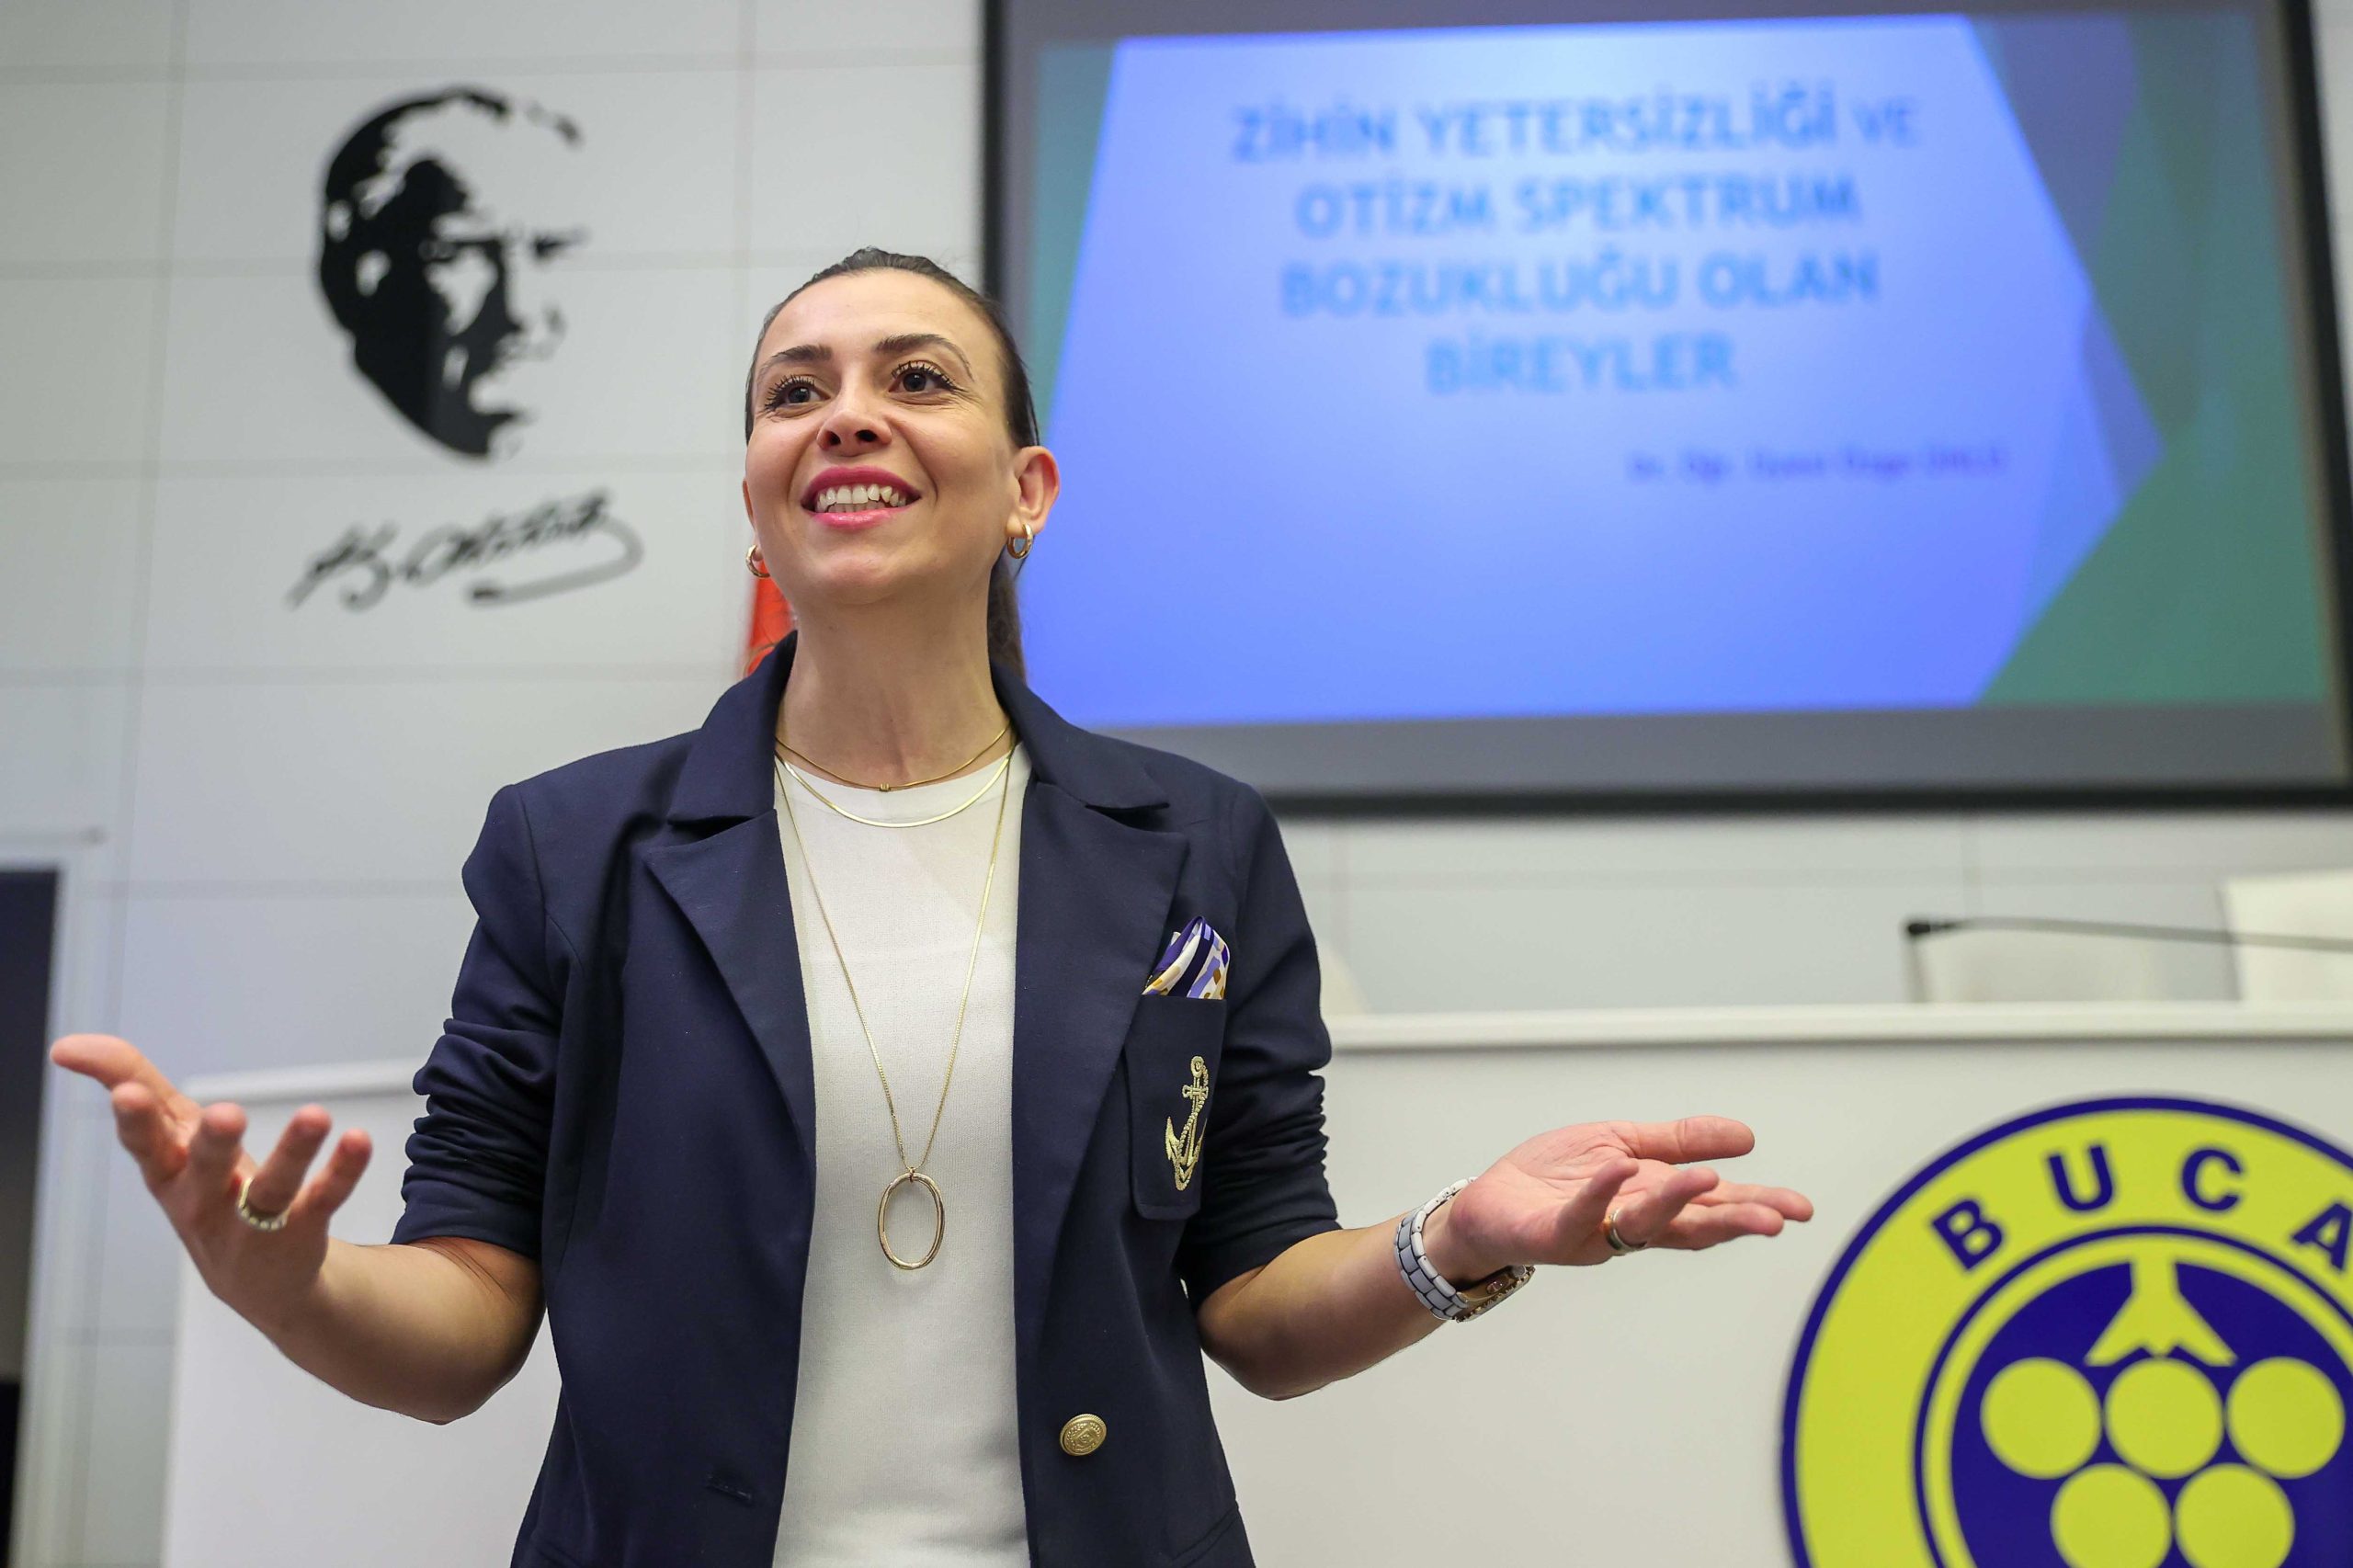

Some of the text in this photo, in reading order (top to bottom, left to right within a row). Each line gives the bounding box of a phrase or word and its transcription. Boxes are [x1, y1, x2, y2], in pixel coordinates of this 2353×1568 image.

[1233, 82, 1920, 163] ZİHİN YETERSİZLİĞİ VE
[1295, 171, 1860, 237] OTİZM SPEKTRUM
[1281, 244, 1878, 317] BOZUKLUĞU OLAN
[1427, 331, 1736, 394] BİREYLER
[1930, 1144, 2353, 1272] BUCA
